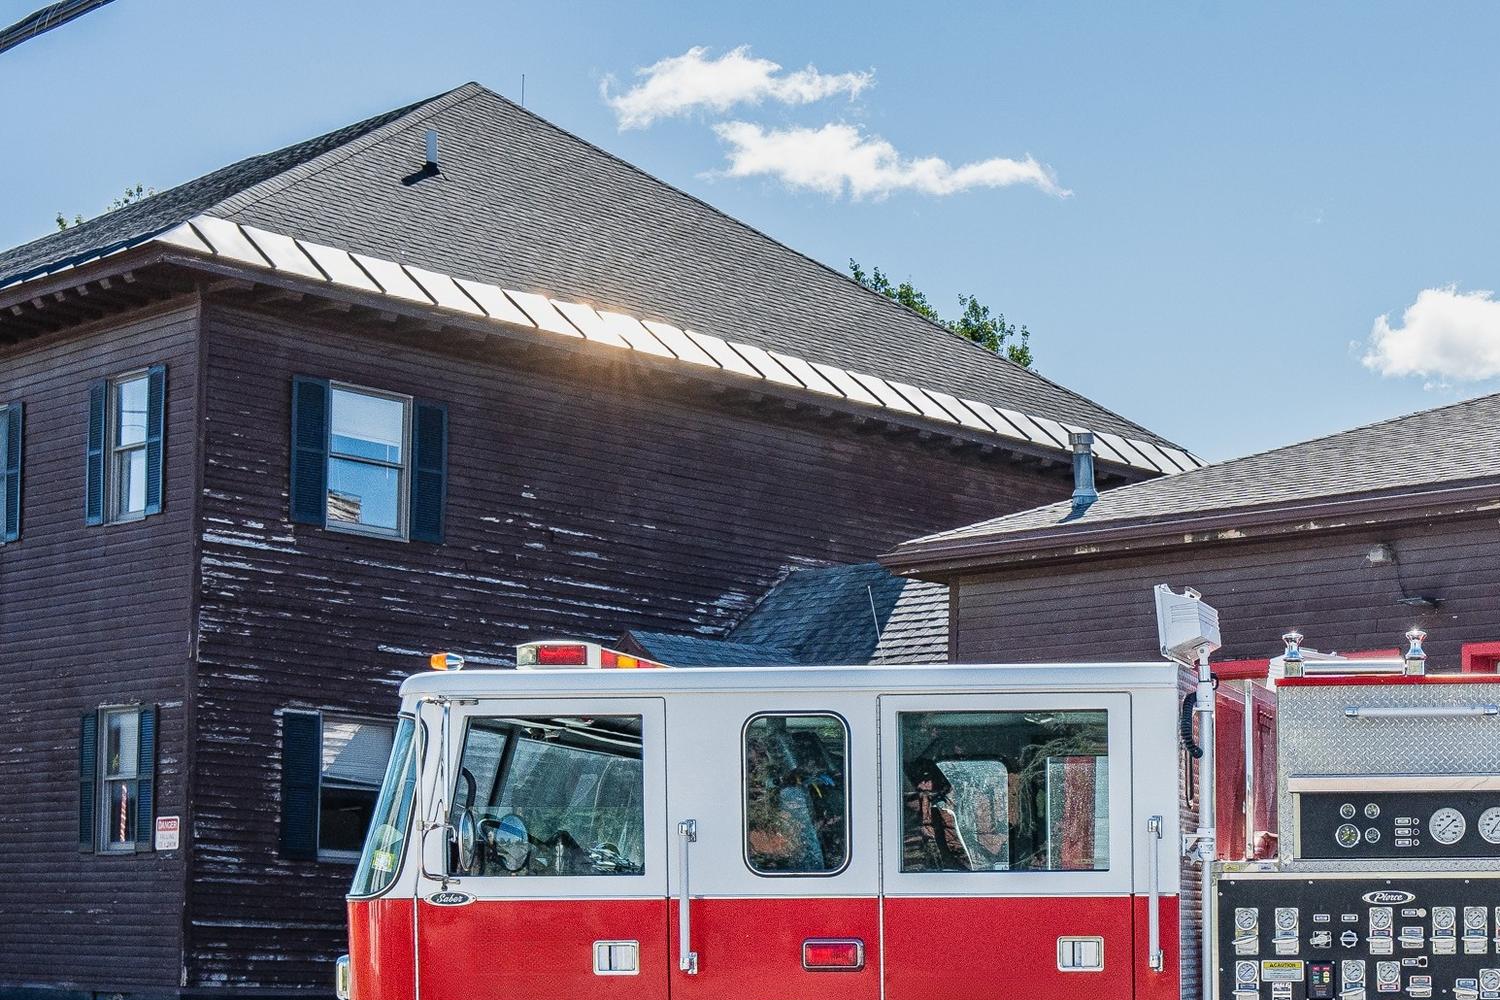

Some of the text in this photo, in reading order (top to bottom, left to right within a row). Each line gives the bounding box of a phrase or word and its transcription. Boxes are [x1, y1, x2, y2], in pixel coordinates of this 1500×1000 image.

[158, 820, 178, 830] DANGER
[436, 893, 463, 903] Saber
[1373, 892, 1403, 902] Pierce
